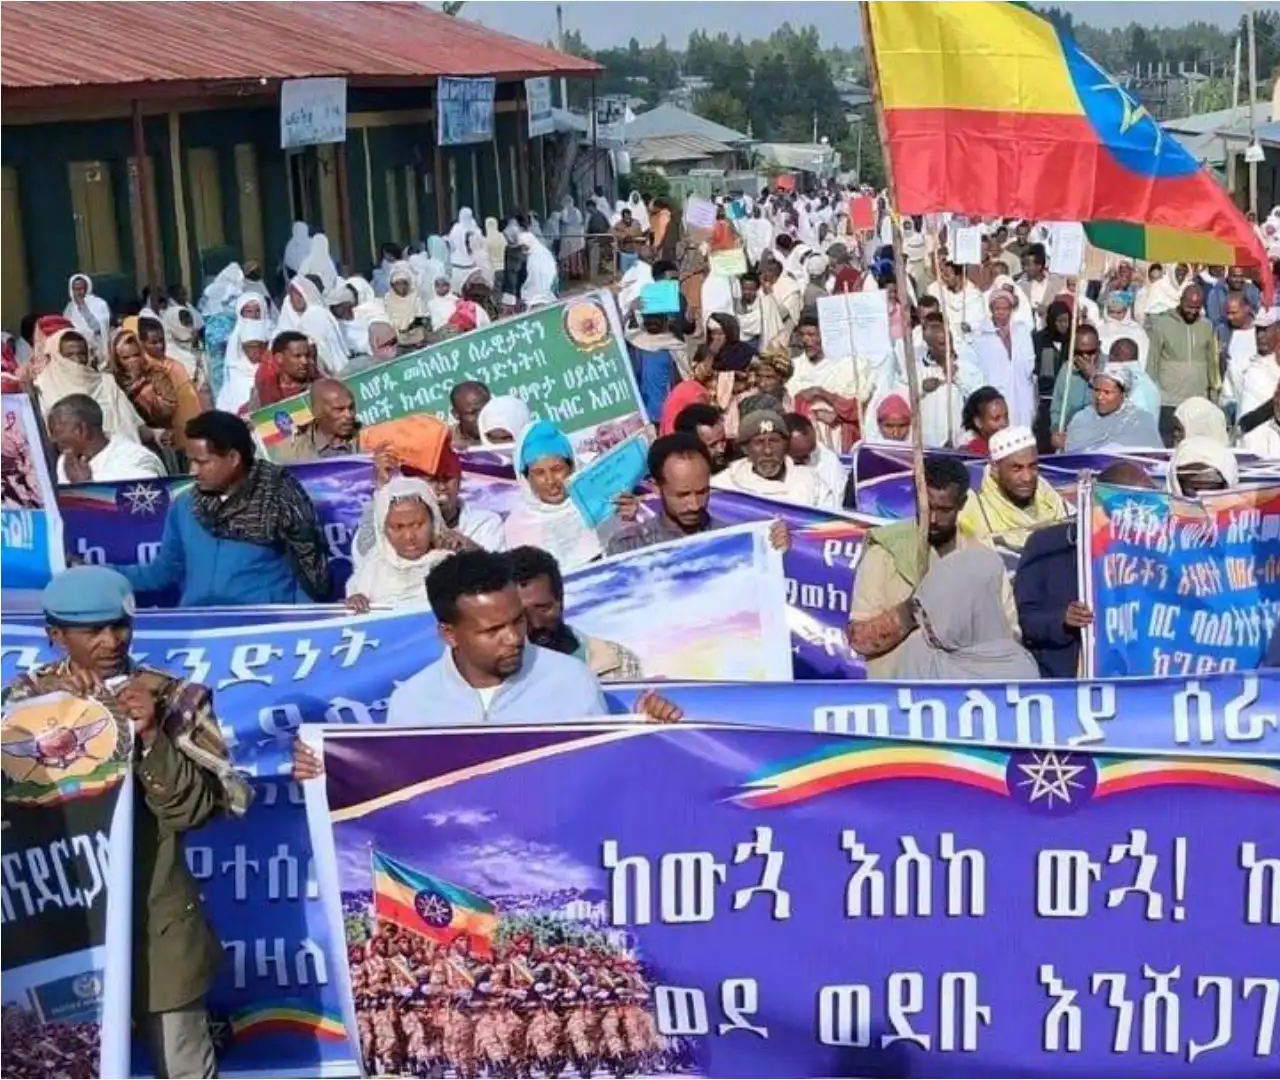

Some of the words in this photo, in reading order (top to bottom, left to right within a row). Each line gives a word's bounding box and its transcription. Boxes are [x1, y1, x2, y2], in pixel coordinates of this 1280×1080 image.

[133, 627, 380, 692] ንድነት
[814, 682, 1116, 747] መከላከያ
[841, 829, 989, 920] እስከ
[653, 975, 771, 1041] ወደ
[816, 970, 994, 1053] ወደቡ
